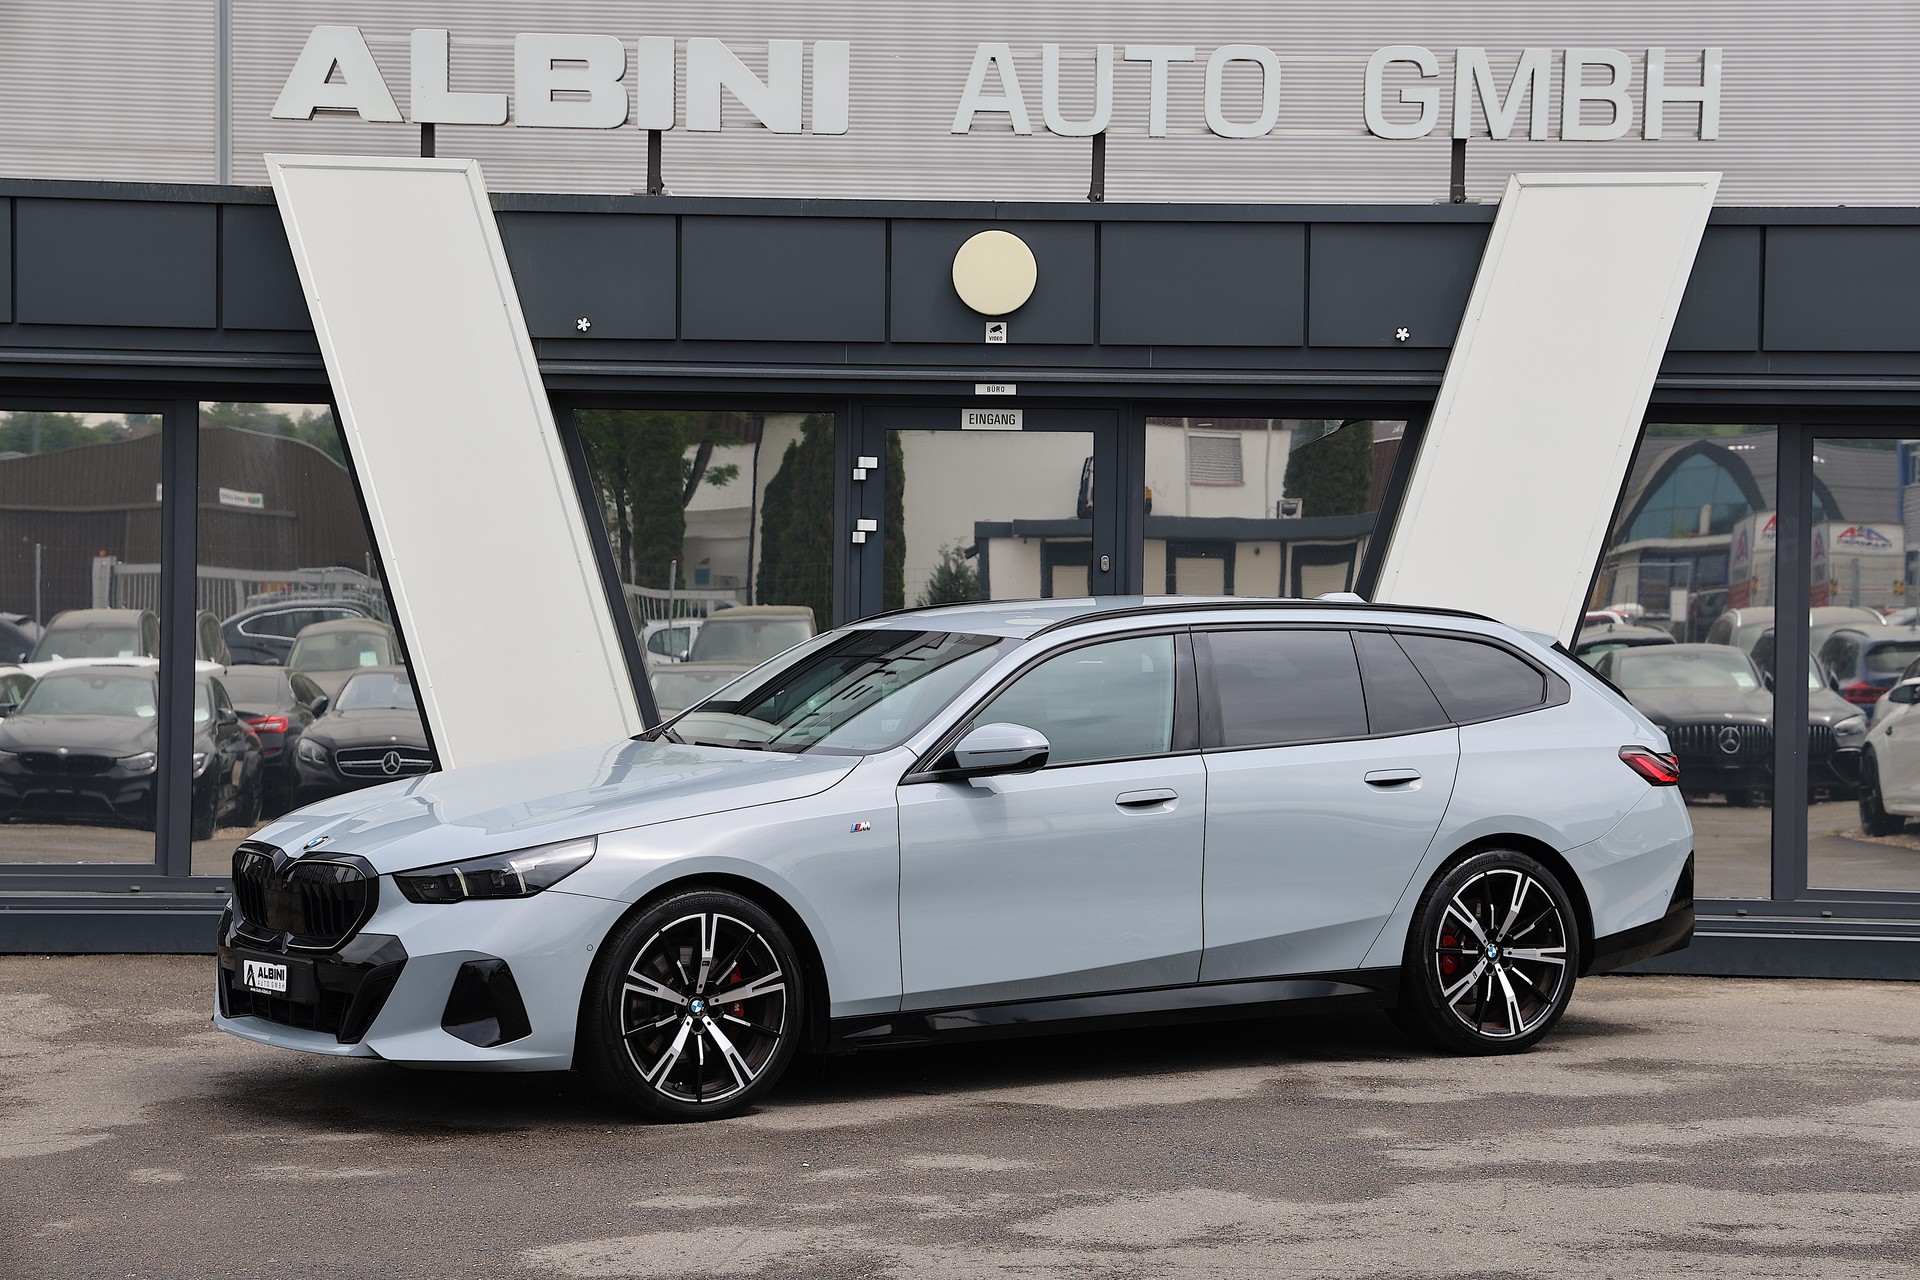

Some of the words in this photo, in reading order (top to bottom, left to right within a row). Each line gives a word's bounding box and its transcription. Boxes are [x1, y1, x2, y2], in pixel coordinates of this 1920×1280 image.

[271, 25, 851, 135] ALBINI
[951, 43, 1282, 138] AUTO
[1363, 45, 1724, 142] GMBH
[986, 384, 1005, 393] BÜRO
[969, 413, 1016, 425] EINGANG
[258, 967, 285, 981] ALBINI
